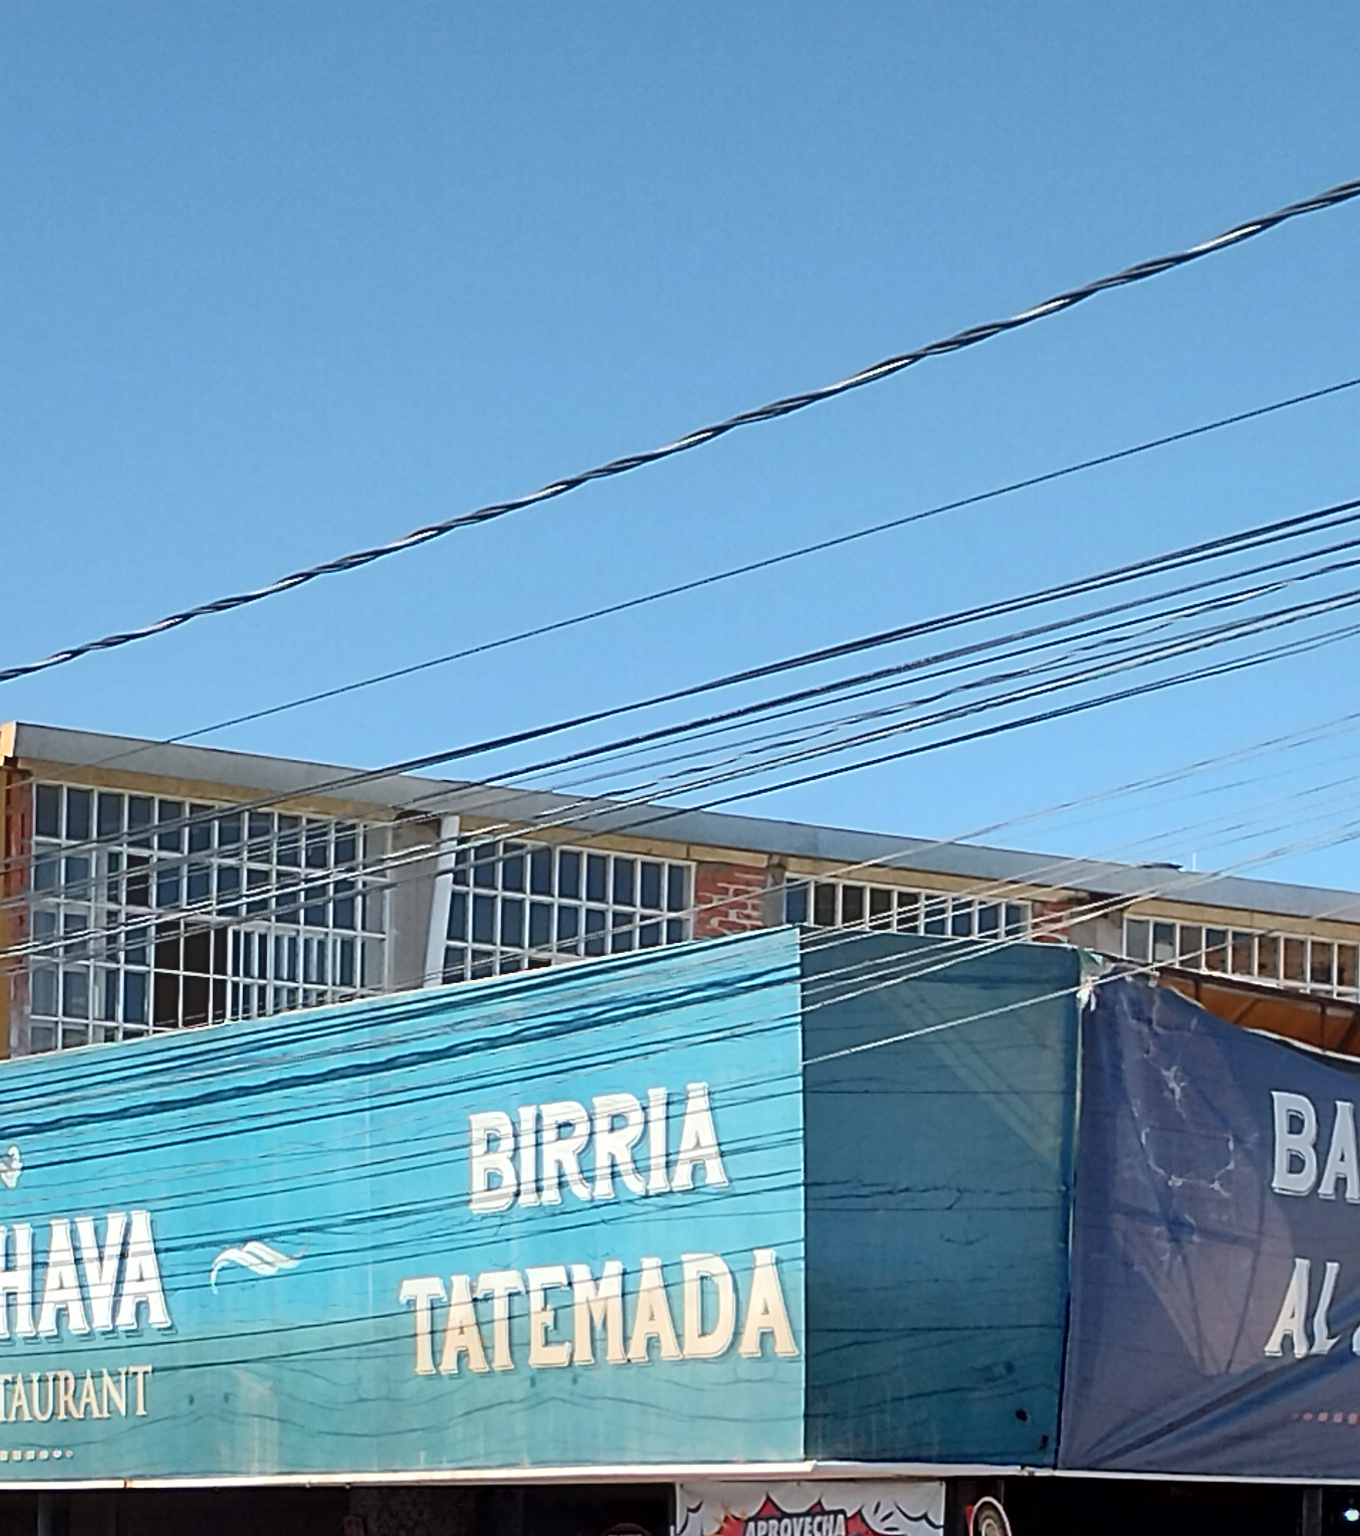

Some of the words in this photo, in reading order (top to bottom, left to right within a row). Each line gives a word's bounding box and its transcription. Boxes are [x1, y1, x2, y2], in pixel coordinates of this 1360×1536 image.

[467, 1080, 732, 1216] BIRRIA
[398, 1247, 801, 1376] TATEMADA
[1263, 1257, 1342, 1359] AL
